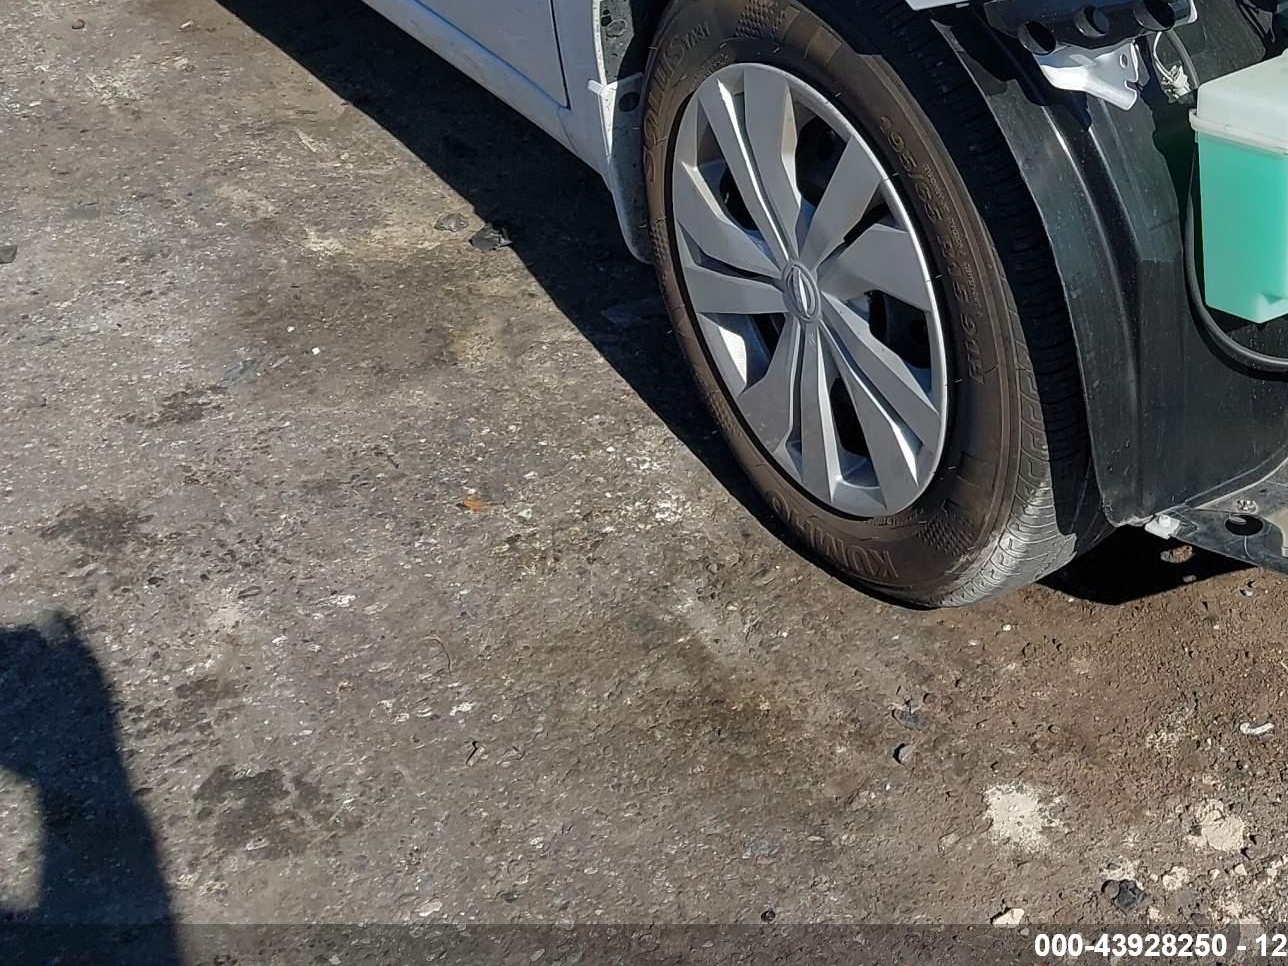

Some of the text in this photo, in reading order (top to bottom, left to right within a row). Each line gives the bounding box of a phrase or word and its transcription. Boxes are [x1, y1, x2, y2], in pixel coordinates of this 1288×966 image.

[878, 114, 945, 227] 195/65
[959, 312, 986, 384] 91H
[771, 489, 900, 579] KUMHO
